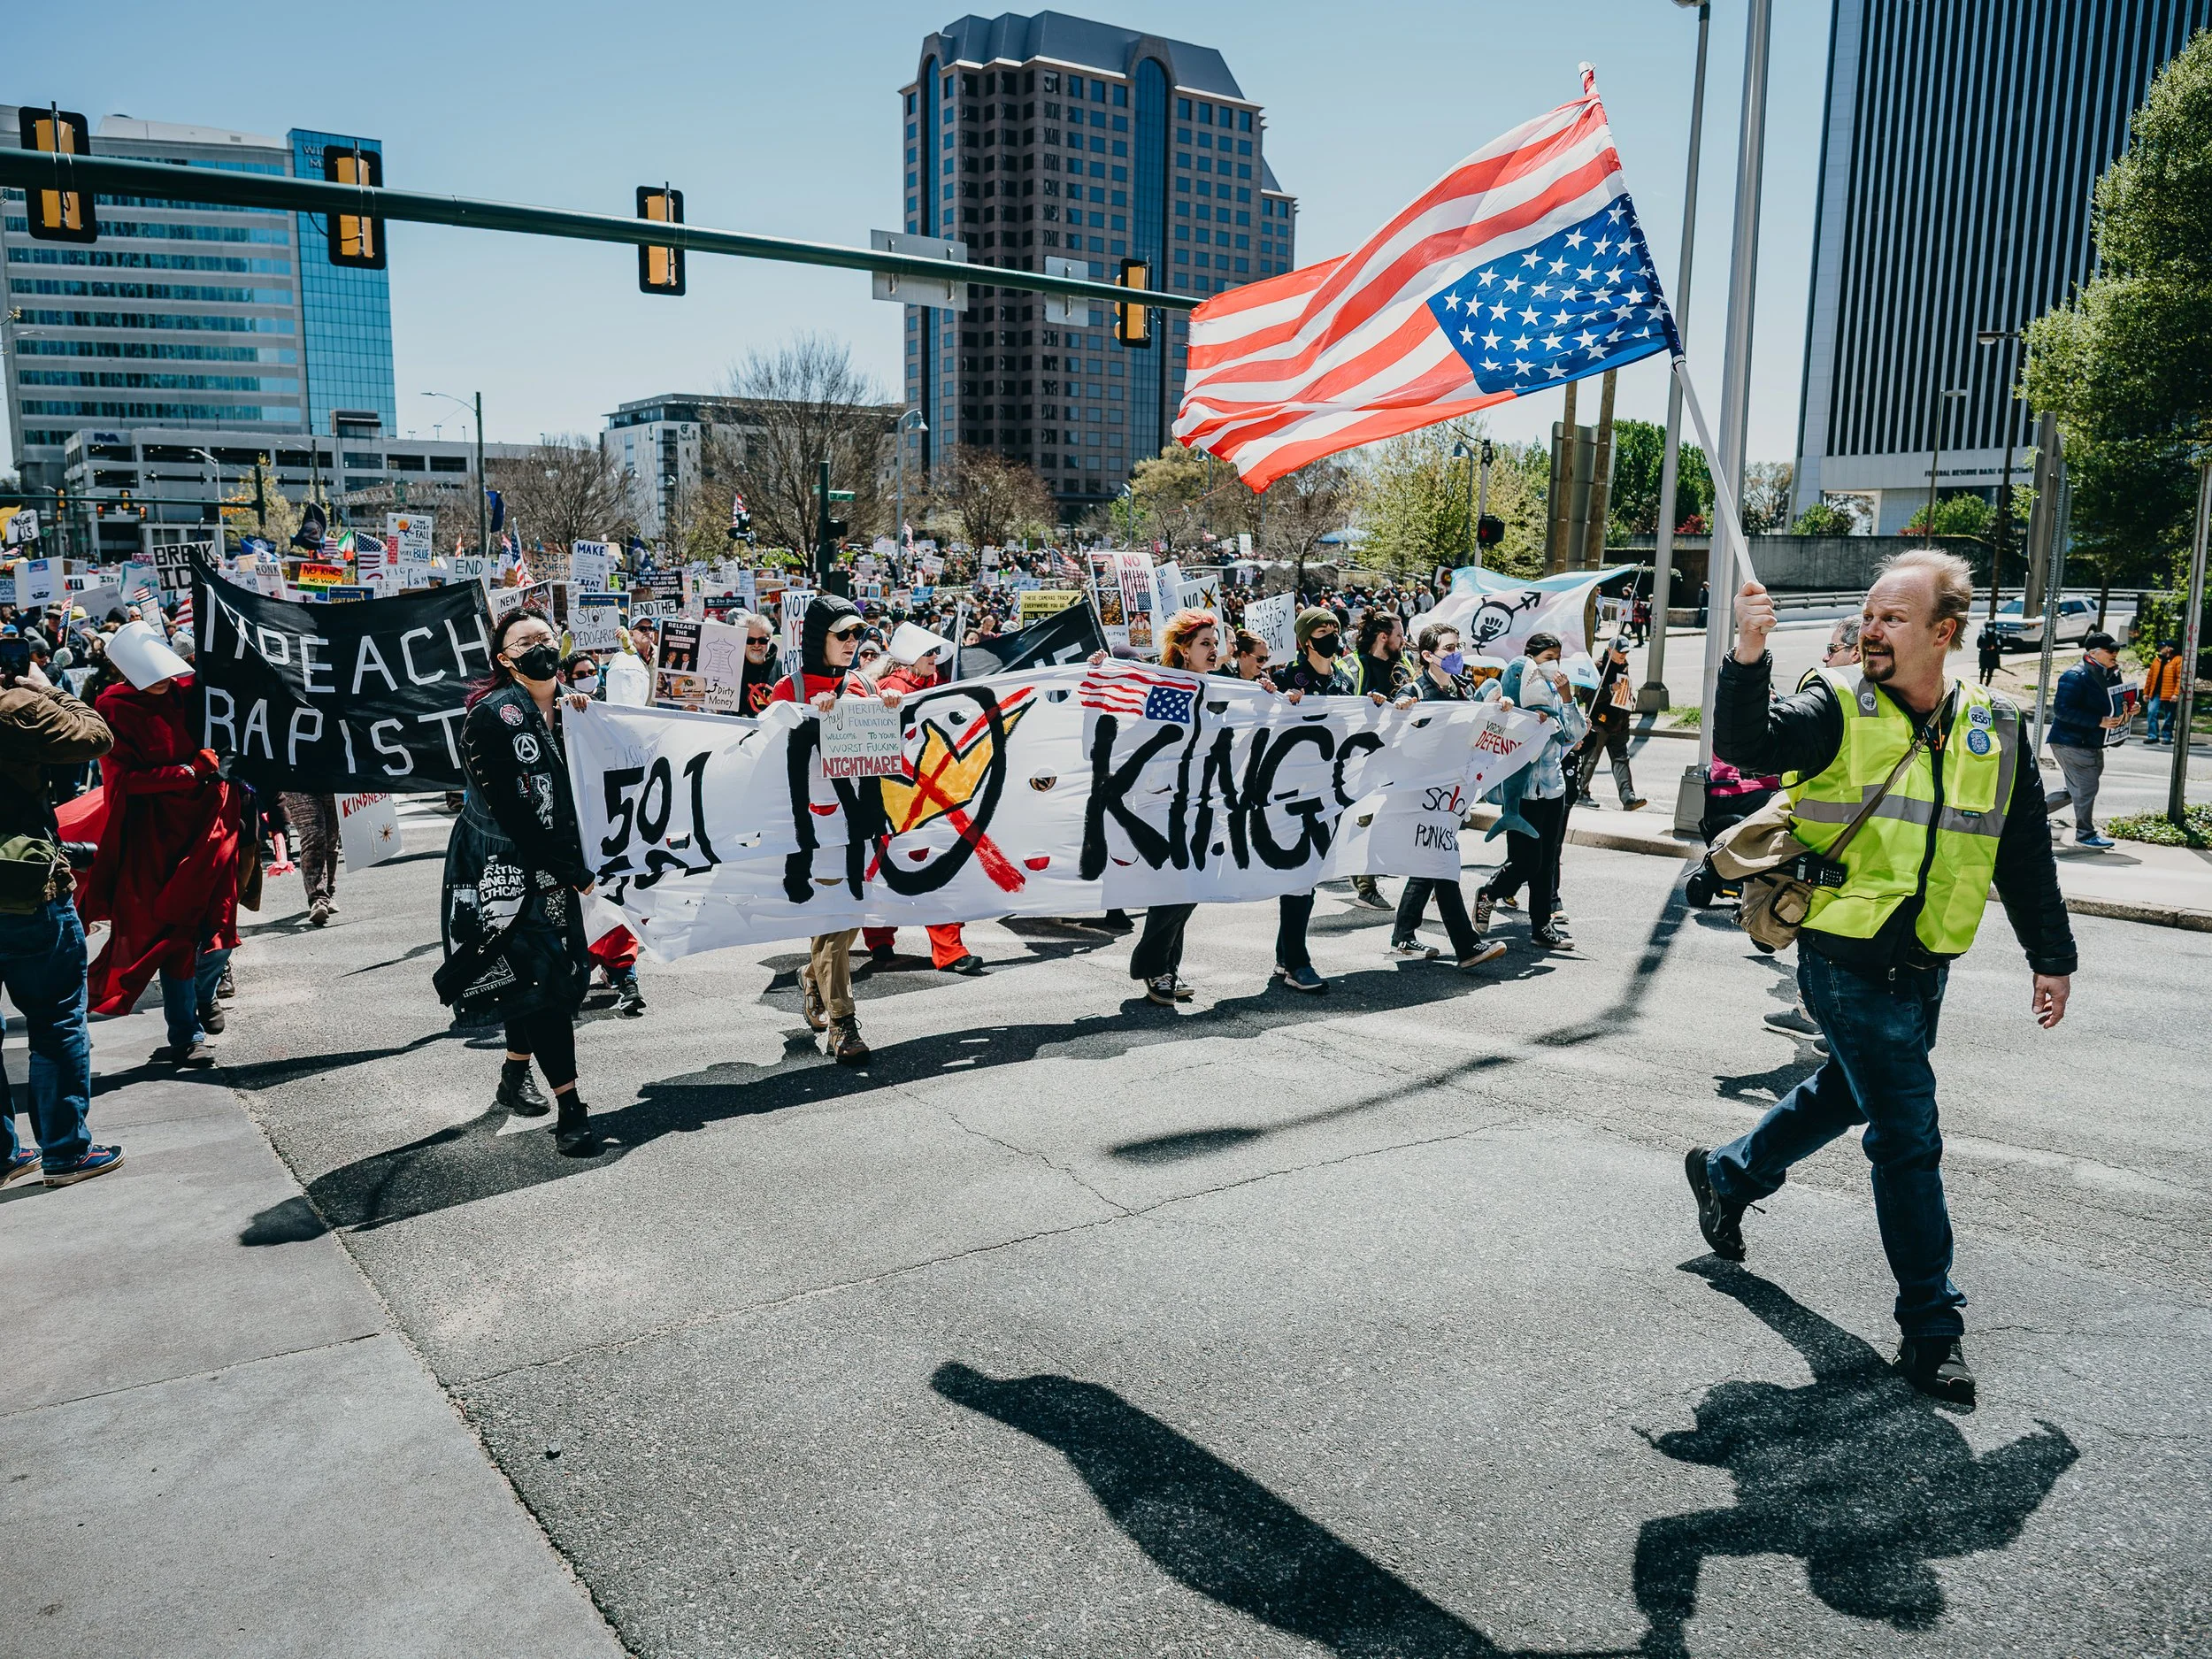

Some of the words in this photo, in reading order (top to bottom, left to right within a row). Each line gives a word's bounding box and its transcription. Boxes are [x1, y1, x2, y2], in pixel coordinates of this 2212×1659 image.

[415, 530, 429, 540] FALL
[413, 549, 429, 559] BLUE
[577, 543, 604, 557] MAKE
[538, 554, 566, 563] STOP
[1122, 555, 1141, 567] NO
[256, 565, 279, 574] HONK
[303, 564, 318, 575] NO
[455, 559, 483, 575] END
[500, 595, 518, 608] NEW
[1256, 597, 1280, 614] MAKE
[632, 603, 654, 617] END
[655, 600, 677, 615] THE
[668, 622, 696, 631] RELEASE
[718, 687, 734, 697] Dirty
[709, 695, 733, 709] Money
[849, 717, 897, 726] FOUNDATION:
[1971, 713, 1992, 725] RESIST
[204, 686, 469, 776] RAPIST
[829, 743, 863, 753] WORST
[866, 742, 899, 752] FUCKING
[821, 755, 901, 778] NIGHTMARE
[463, 989, 480, 998] LEAVE
[480, 976, 517, 993] EVERYTHING
